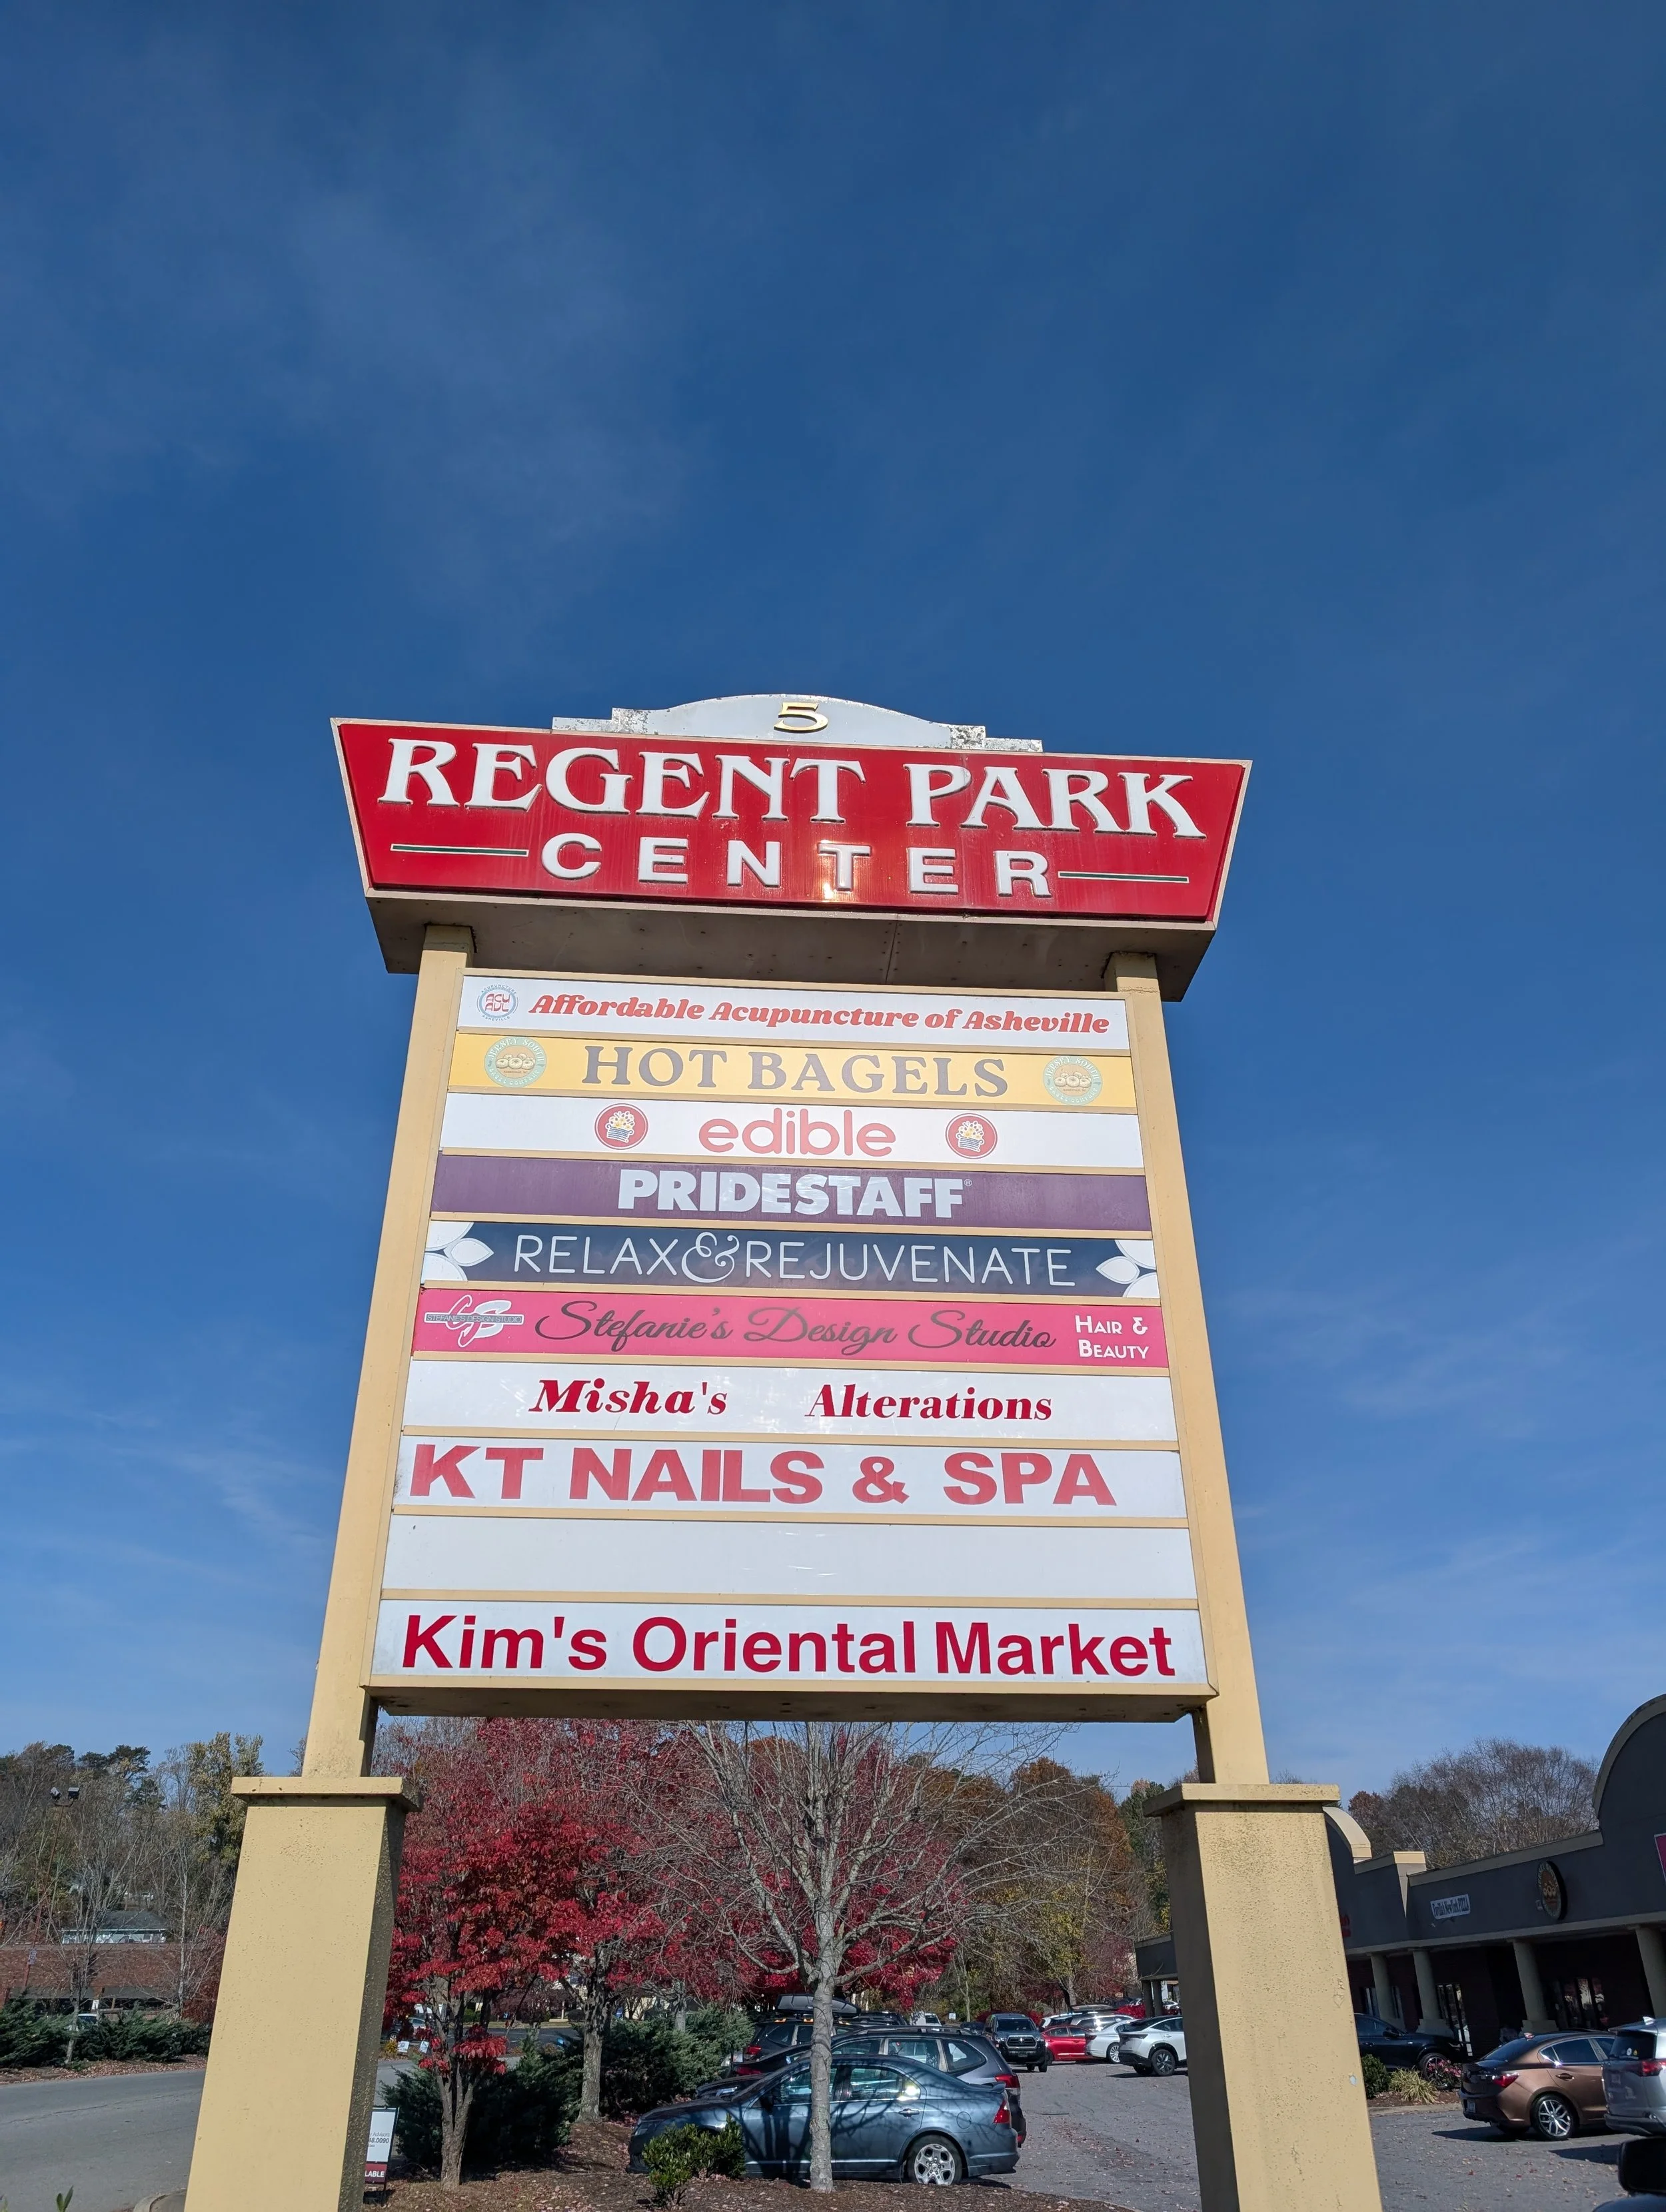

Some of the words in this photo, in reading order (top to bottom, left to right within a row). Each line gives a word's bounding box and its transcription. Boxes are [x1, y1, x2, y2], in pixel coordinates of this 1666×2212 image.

[774, 702, 828, 734] 5
[378, 738, 866, 823] REGENT
[902, 764, 1206, 839] PARK
[542, 832, 1052, 897] CENTER
[486, 993, 510, 1003] ACU
[528, 994, 705, 1019] Affordable
[709, 1002, 919, 1027] Acupuncture
[925, 1009, 963, 1029] of
[962, 1011, 1110, 1034] Asheville
[488, 1038, 518, 1059] JERSEY
[582, 1046, 727, 1087] HOT
[748, 1051, 1008, 1097] BAGELS
[698, 1108, 896, 1157] edible
[618, 1169, 964, 1218] PRIDESTAFF
[746, 1241, 1076, 1287] REJUVENATE
[534, 1300, 732, 1353] Stefanie's
[744, 1306, 898, 1356] Design
[908, 1309, 1056, 1349] Studio
[1074, 1315, 1123, 1335] HAIR
[1132, 1317, 1148, 1336] &
[1078, 1339, 1149, 1360] BEAUTY
[528, 1378, 728, 1414] Misha's
[804, 1384, 1052, 1420] Alterations
[410, 1444, 544, 1500] KT
[569, 1447, 824, 1504] NAILS
[852, 1456, 910, 1504] &
[943, 1452, 1117, 1506] SPA
[402, 1615, 607, 1670] Kim's
[632, 1616, 916, 1674] Oriental
[935, 1622, 1176, 1676] Market
